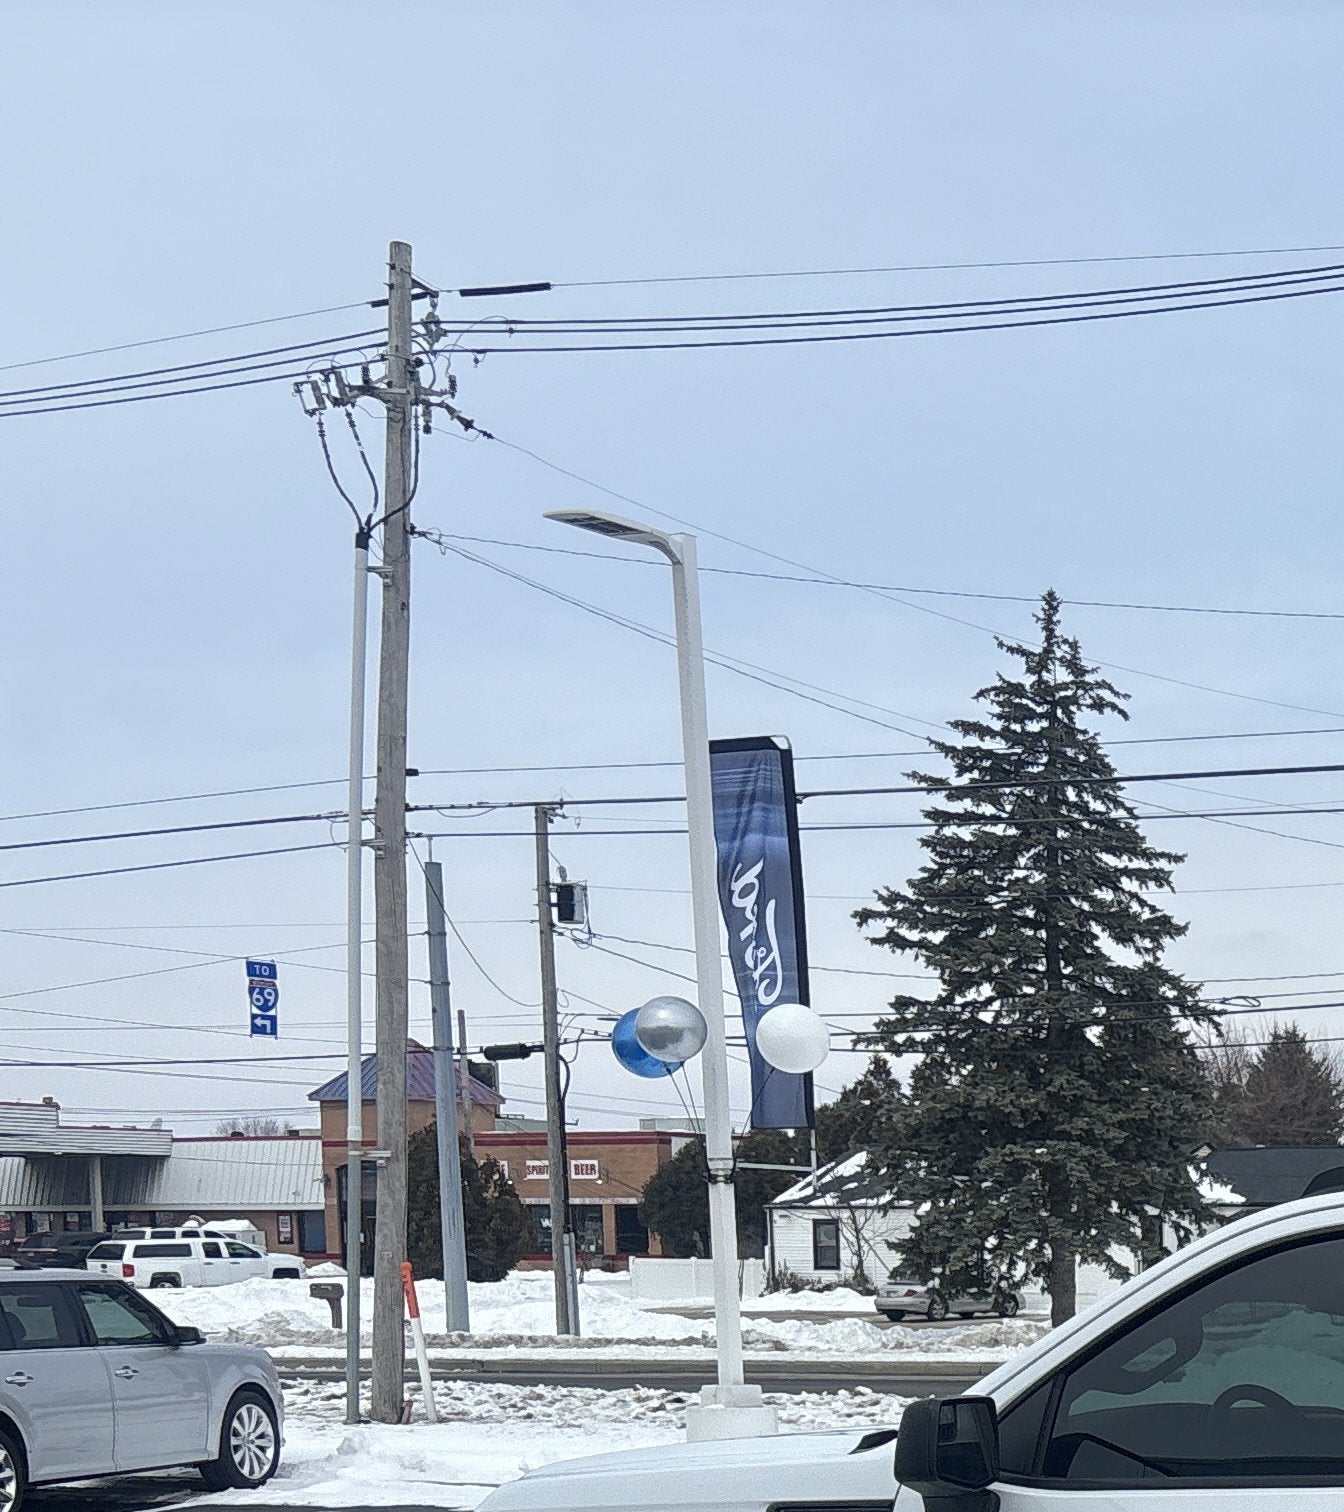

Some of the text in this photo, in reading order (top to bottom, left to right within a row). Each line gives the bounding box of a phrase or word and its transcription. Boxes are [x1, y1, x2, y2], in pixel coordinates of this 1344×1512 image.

[253, 964, 270, 976] TO
[252, 987, 276, 1007] 69
[573, 1164, 597, 1176] BEER
